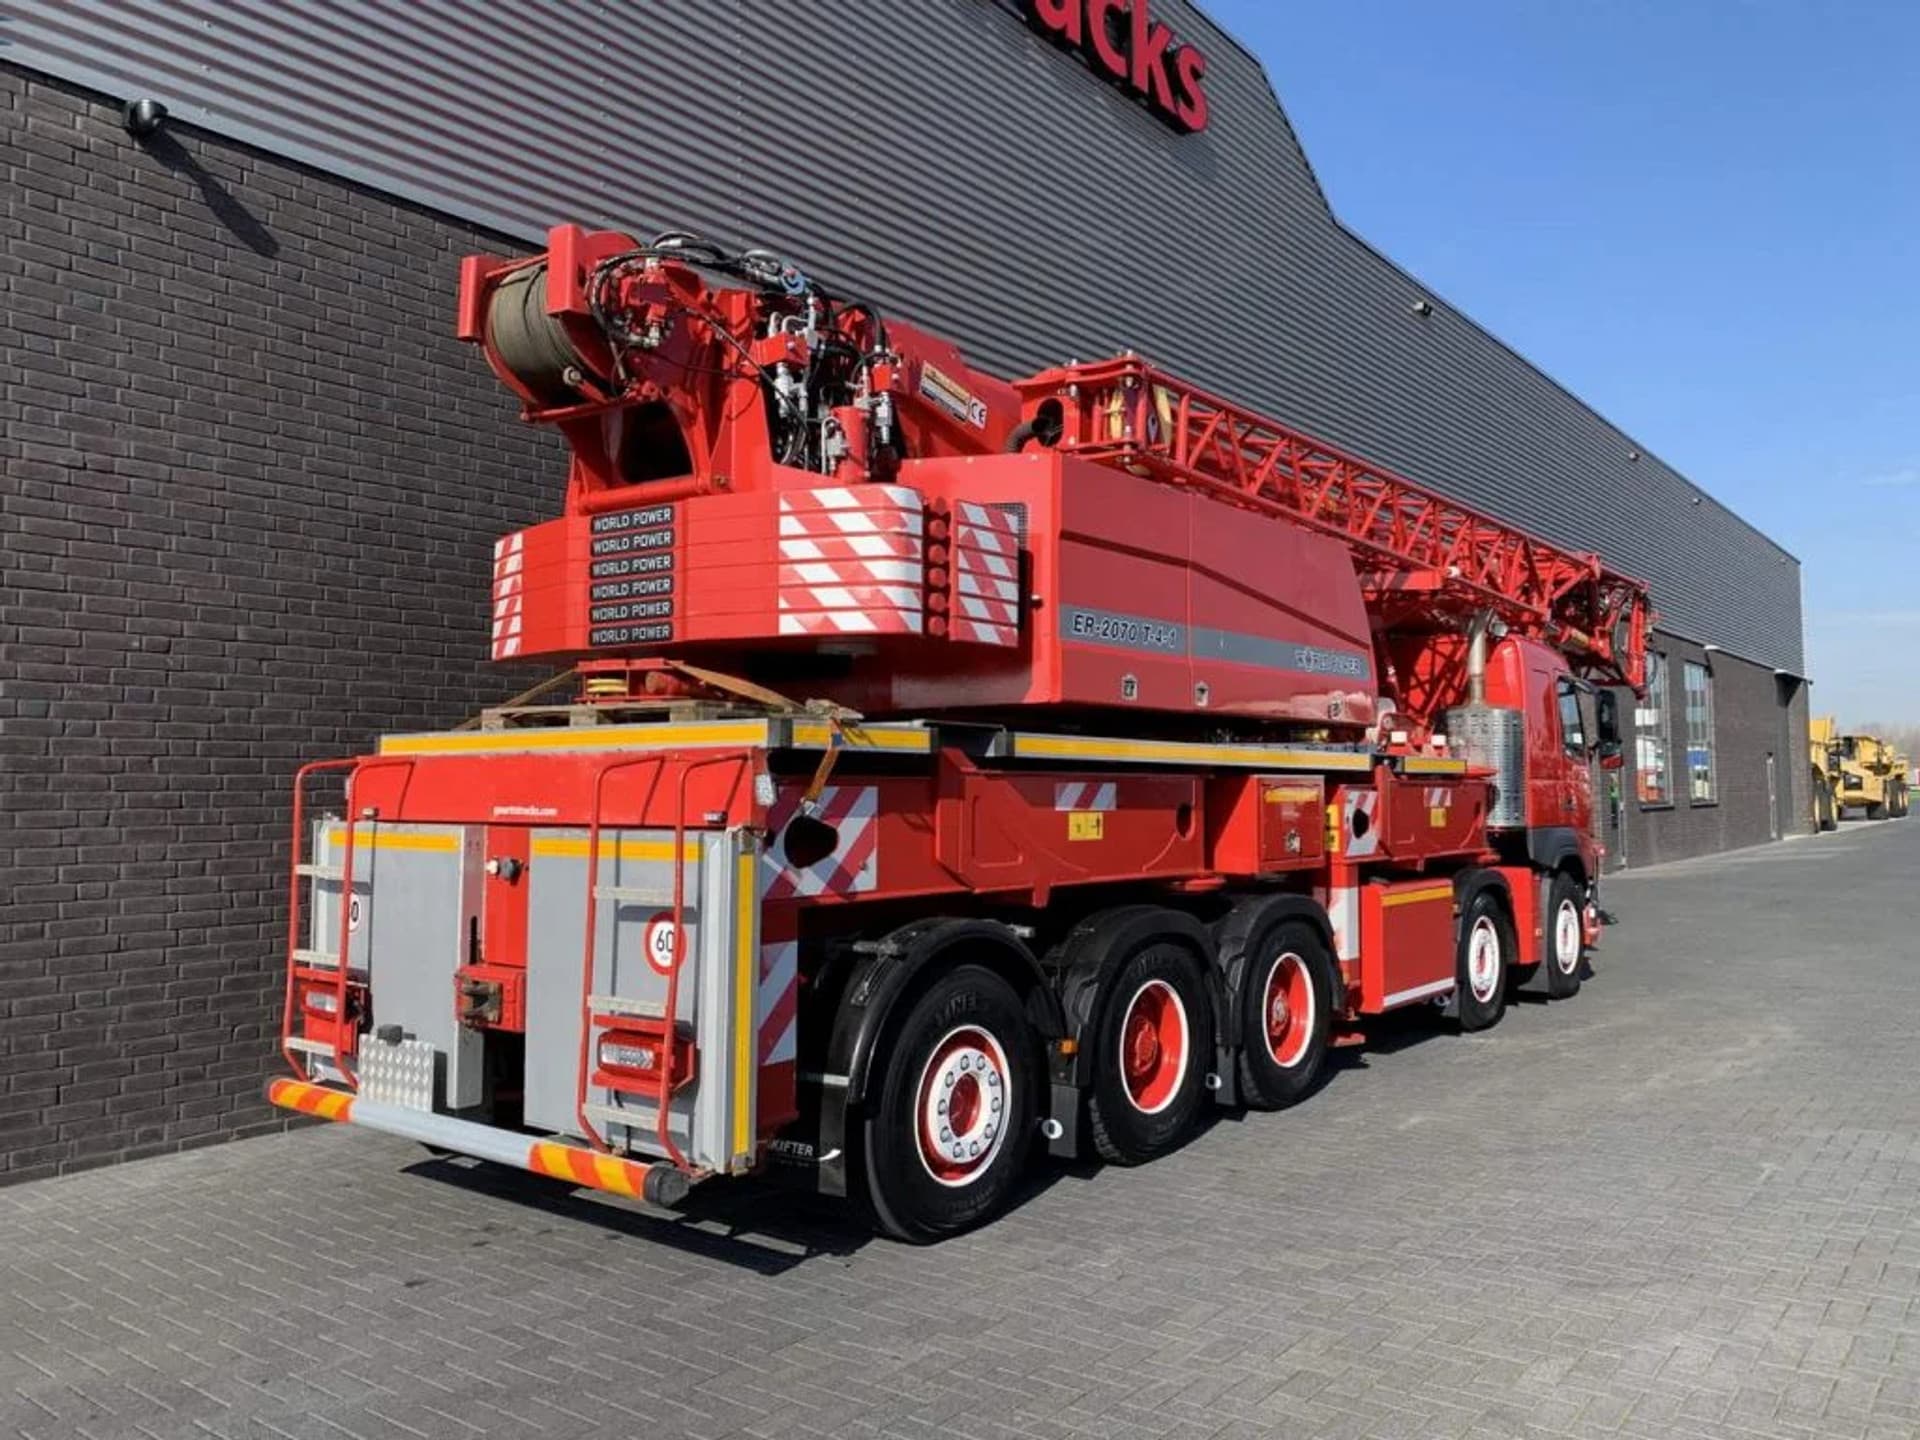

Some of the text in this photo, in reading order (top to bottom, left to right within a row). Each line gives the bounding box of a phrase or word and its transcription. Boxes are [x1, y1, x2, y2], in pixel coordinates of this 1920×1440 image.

[593, 508, 671, 531] WORLD POWER
[593, 531, 671, 553] WORLD POWER
[593, 555, 671, 576] WORLD POWER
[593, 579, 671, 598] WORLD POWER
[591, 602, 671, 621] WORLD POWER
[591, 625, 671, 643] WORLD POWER
[1073, 613, 1137, 642] ER-2070
